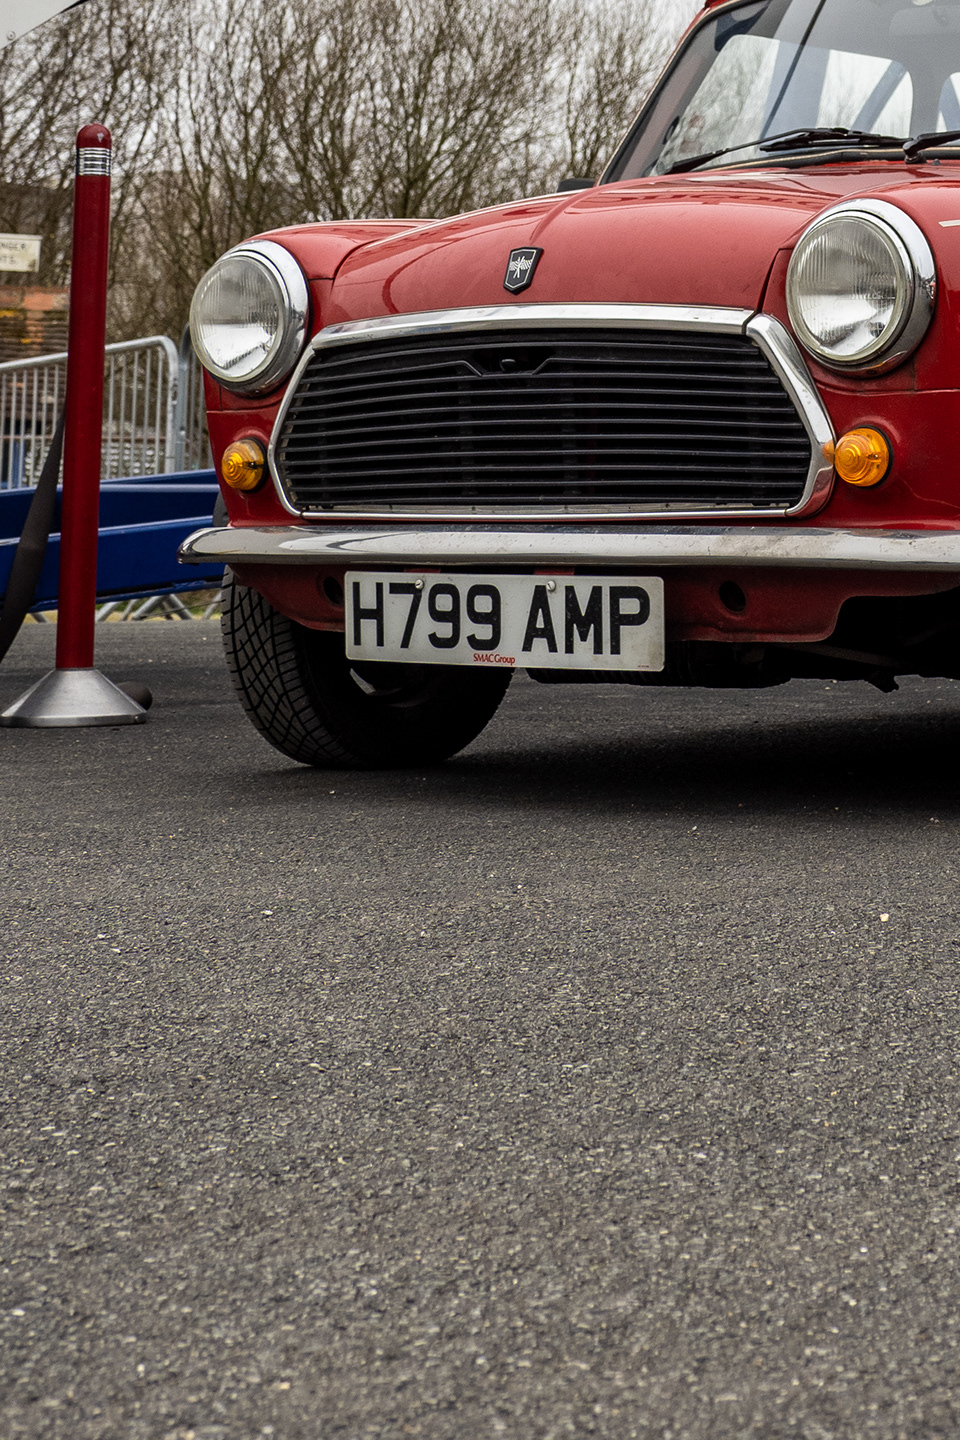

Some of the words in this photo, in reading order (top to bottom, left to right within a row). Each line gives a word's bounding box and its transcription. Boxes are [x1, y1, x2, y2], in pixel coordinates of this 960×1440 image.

[352, 581, 501, 651] H799
[521, 584, 651, 656] AMP
[473, 653, 493, 663] SMAC
[493, 654, 516, 666] Group
